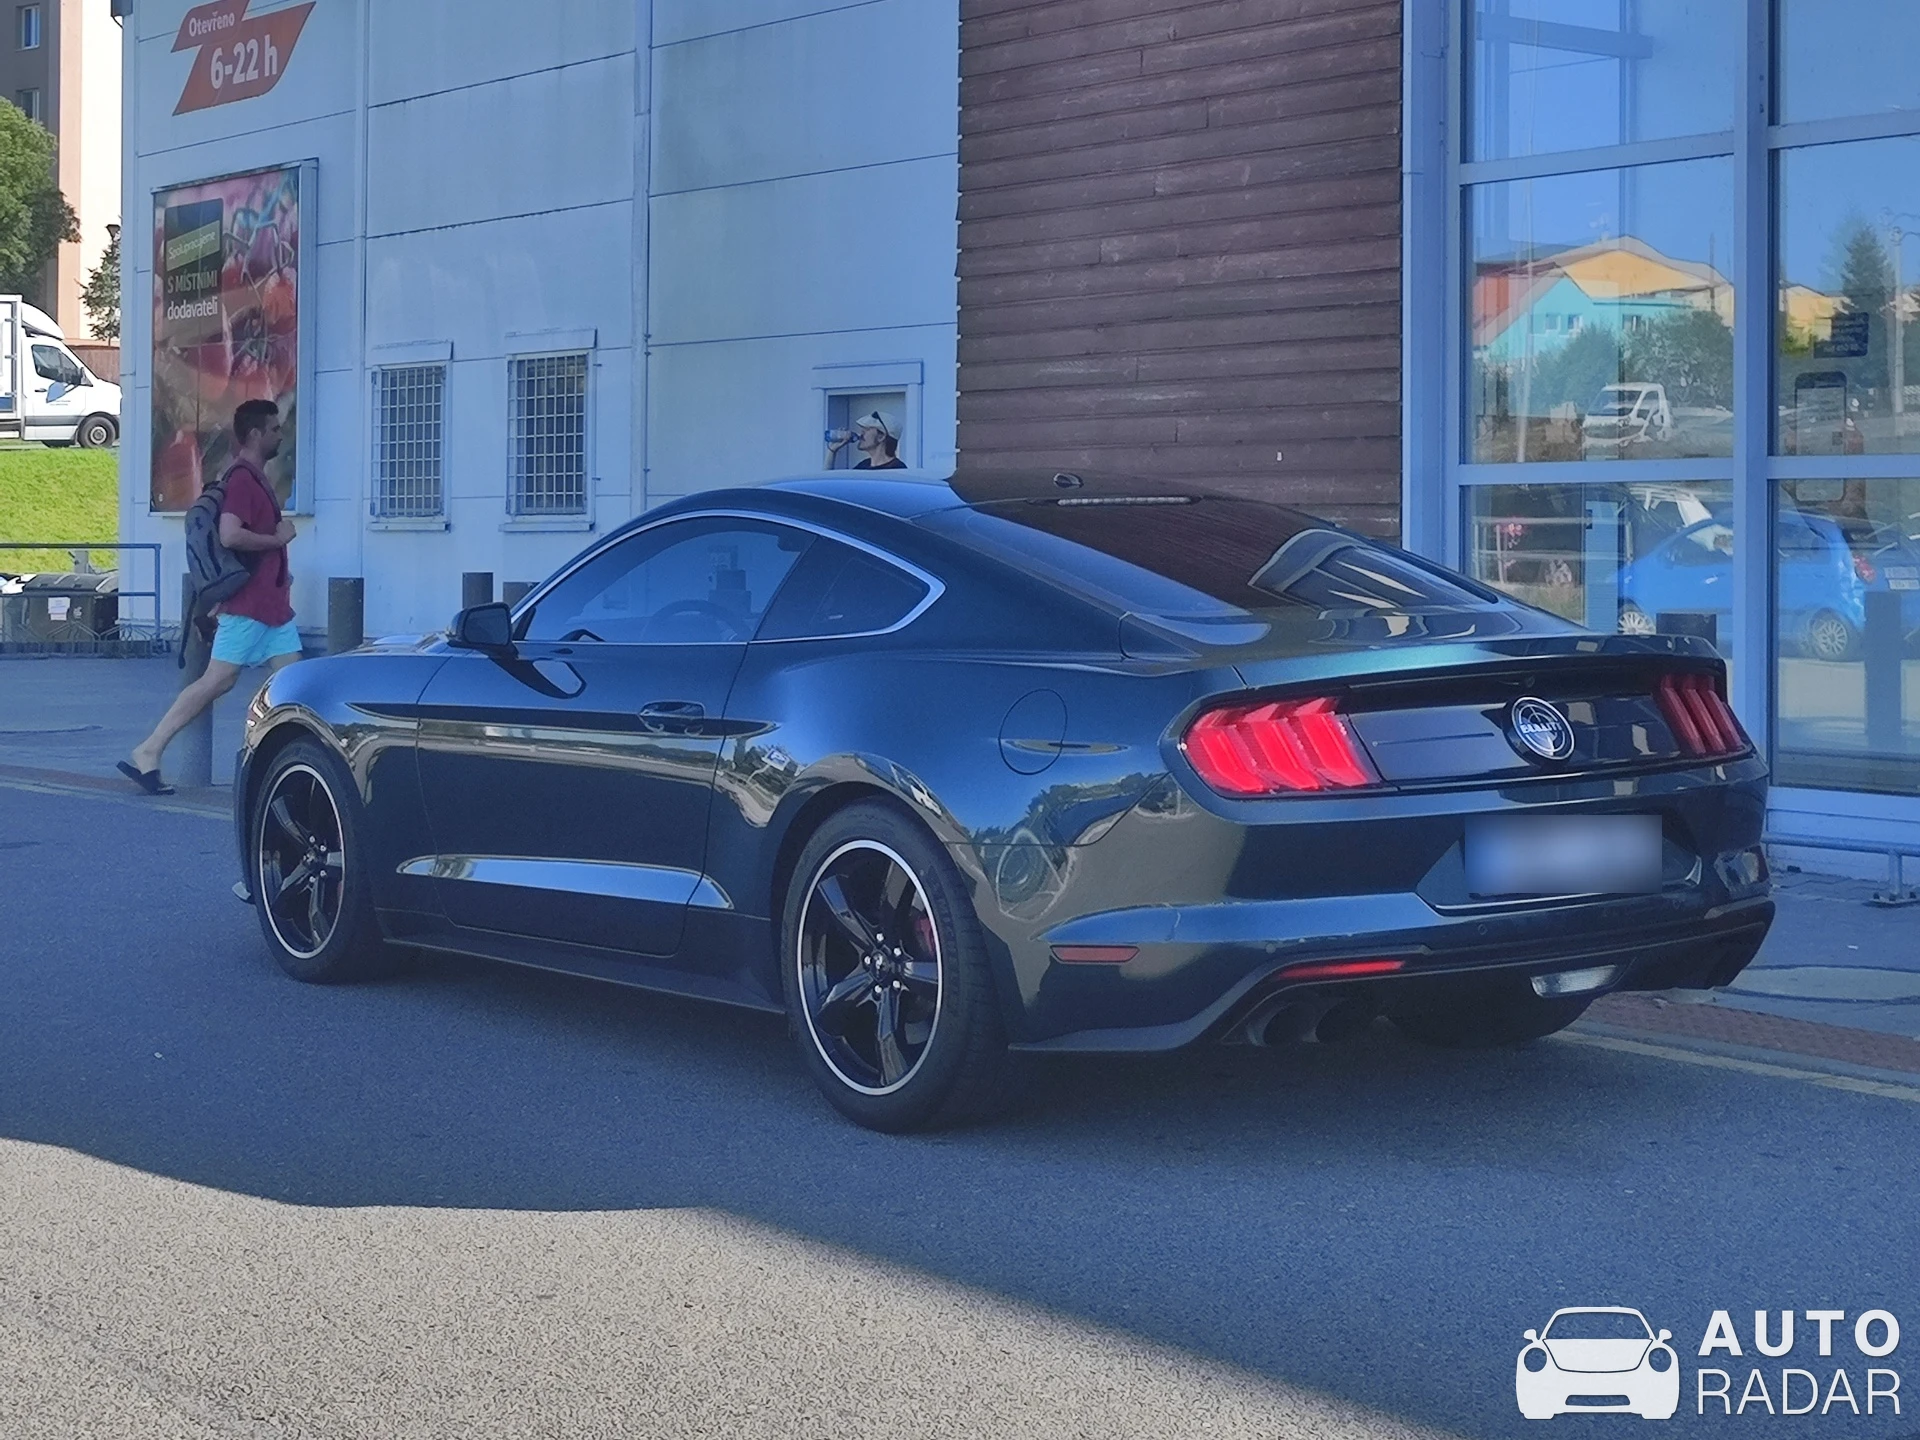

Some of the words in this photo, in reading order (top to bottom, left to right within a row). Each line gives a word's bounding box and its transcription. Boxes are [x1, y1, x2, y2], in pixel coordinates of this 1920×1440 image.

[188, 11, 235, 37] Otevřeno
[211, 39, 259, 89] 6-22
[264, 34, 278, 77] h
[167, 275, 174, 294] S
[175, 267, 218, 293] MÍSTNÍMI
[167, 296, 218, 320] dodavateli
